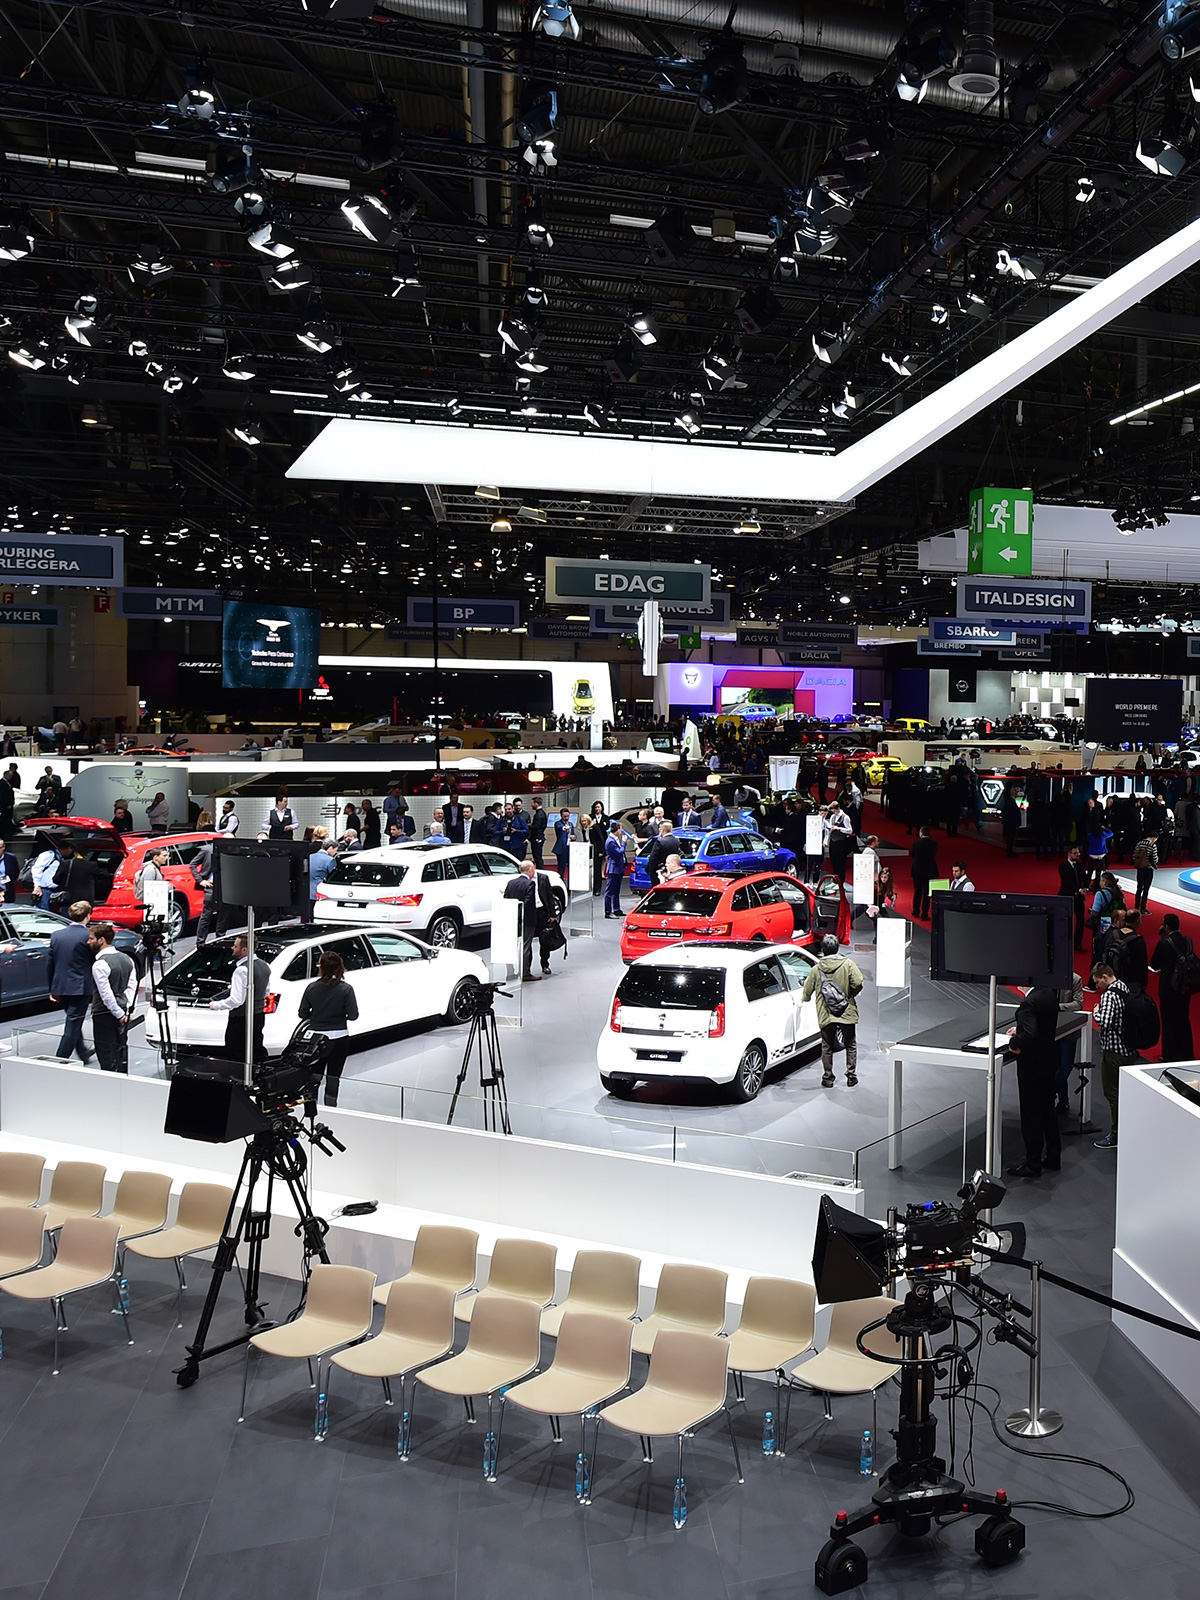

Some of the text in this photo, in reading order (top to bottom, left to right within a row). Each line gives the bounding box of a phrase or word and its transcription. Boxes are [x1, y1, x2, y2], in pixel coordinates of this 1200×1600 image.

[594, 573, 665, 593] EDAG
[99, 597, 107, 608] F
[156, 597, 203, 611] MTM
[975, 591, 1075, 608] ITALDESIGN
[453, 607, 475, 619] BP
[744, 634, 769, 642] AGVS
[809, 631, 850, 639] AUTOMOTIVE
[934, 642, 966, 650] BREMBO
[806, 676, 847, 686] DACIA
[1134, 703, 1158, 711] PREMIERE
